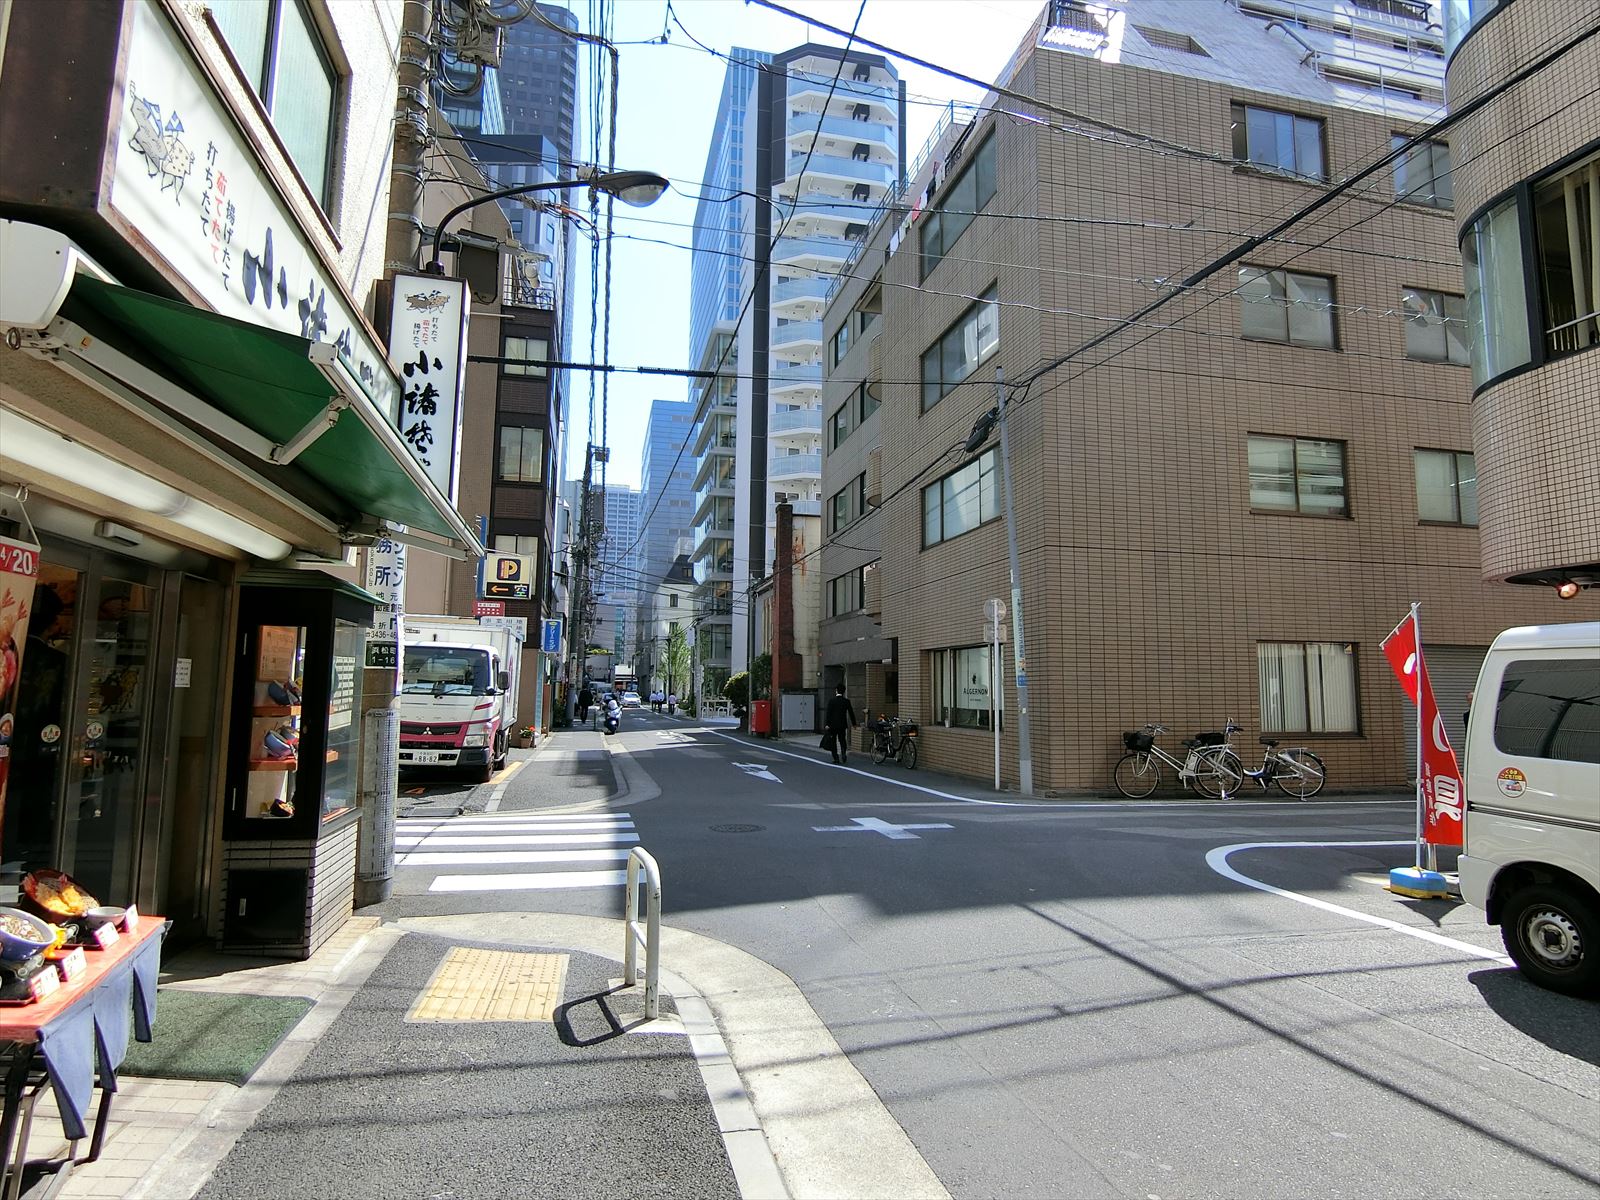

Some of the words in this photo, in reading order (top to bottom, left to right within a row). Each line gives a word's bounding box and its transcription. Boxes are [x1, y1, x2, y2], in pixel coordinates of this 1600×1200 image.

[200, 140, 219, 237] 打ちたて
[221, 199, 236, 292] 揚げたて
[431, 316, 439, 343] 打ちたて
[513, 584, 528, 598] 空
[962, 687, 989, 696] ALGERNON
